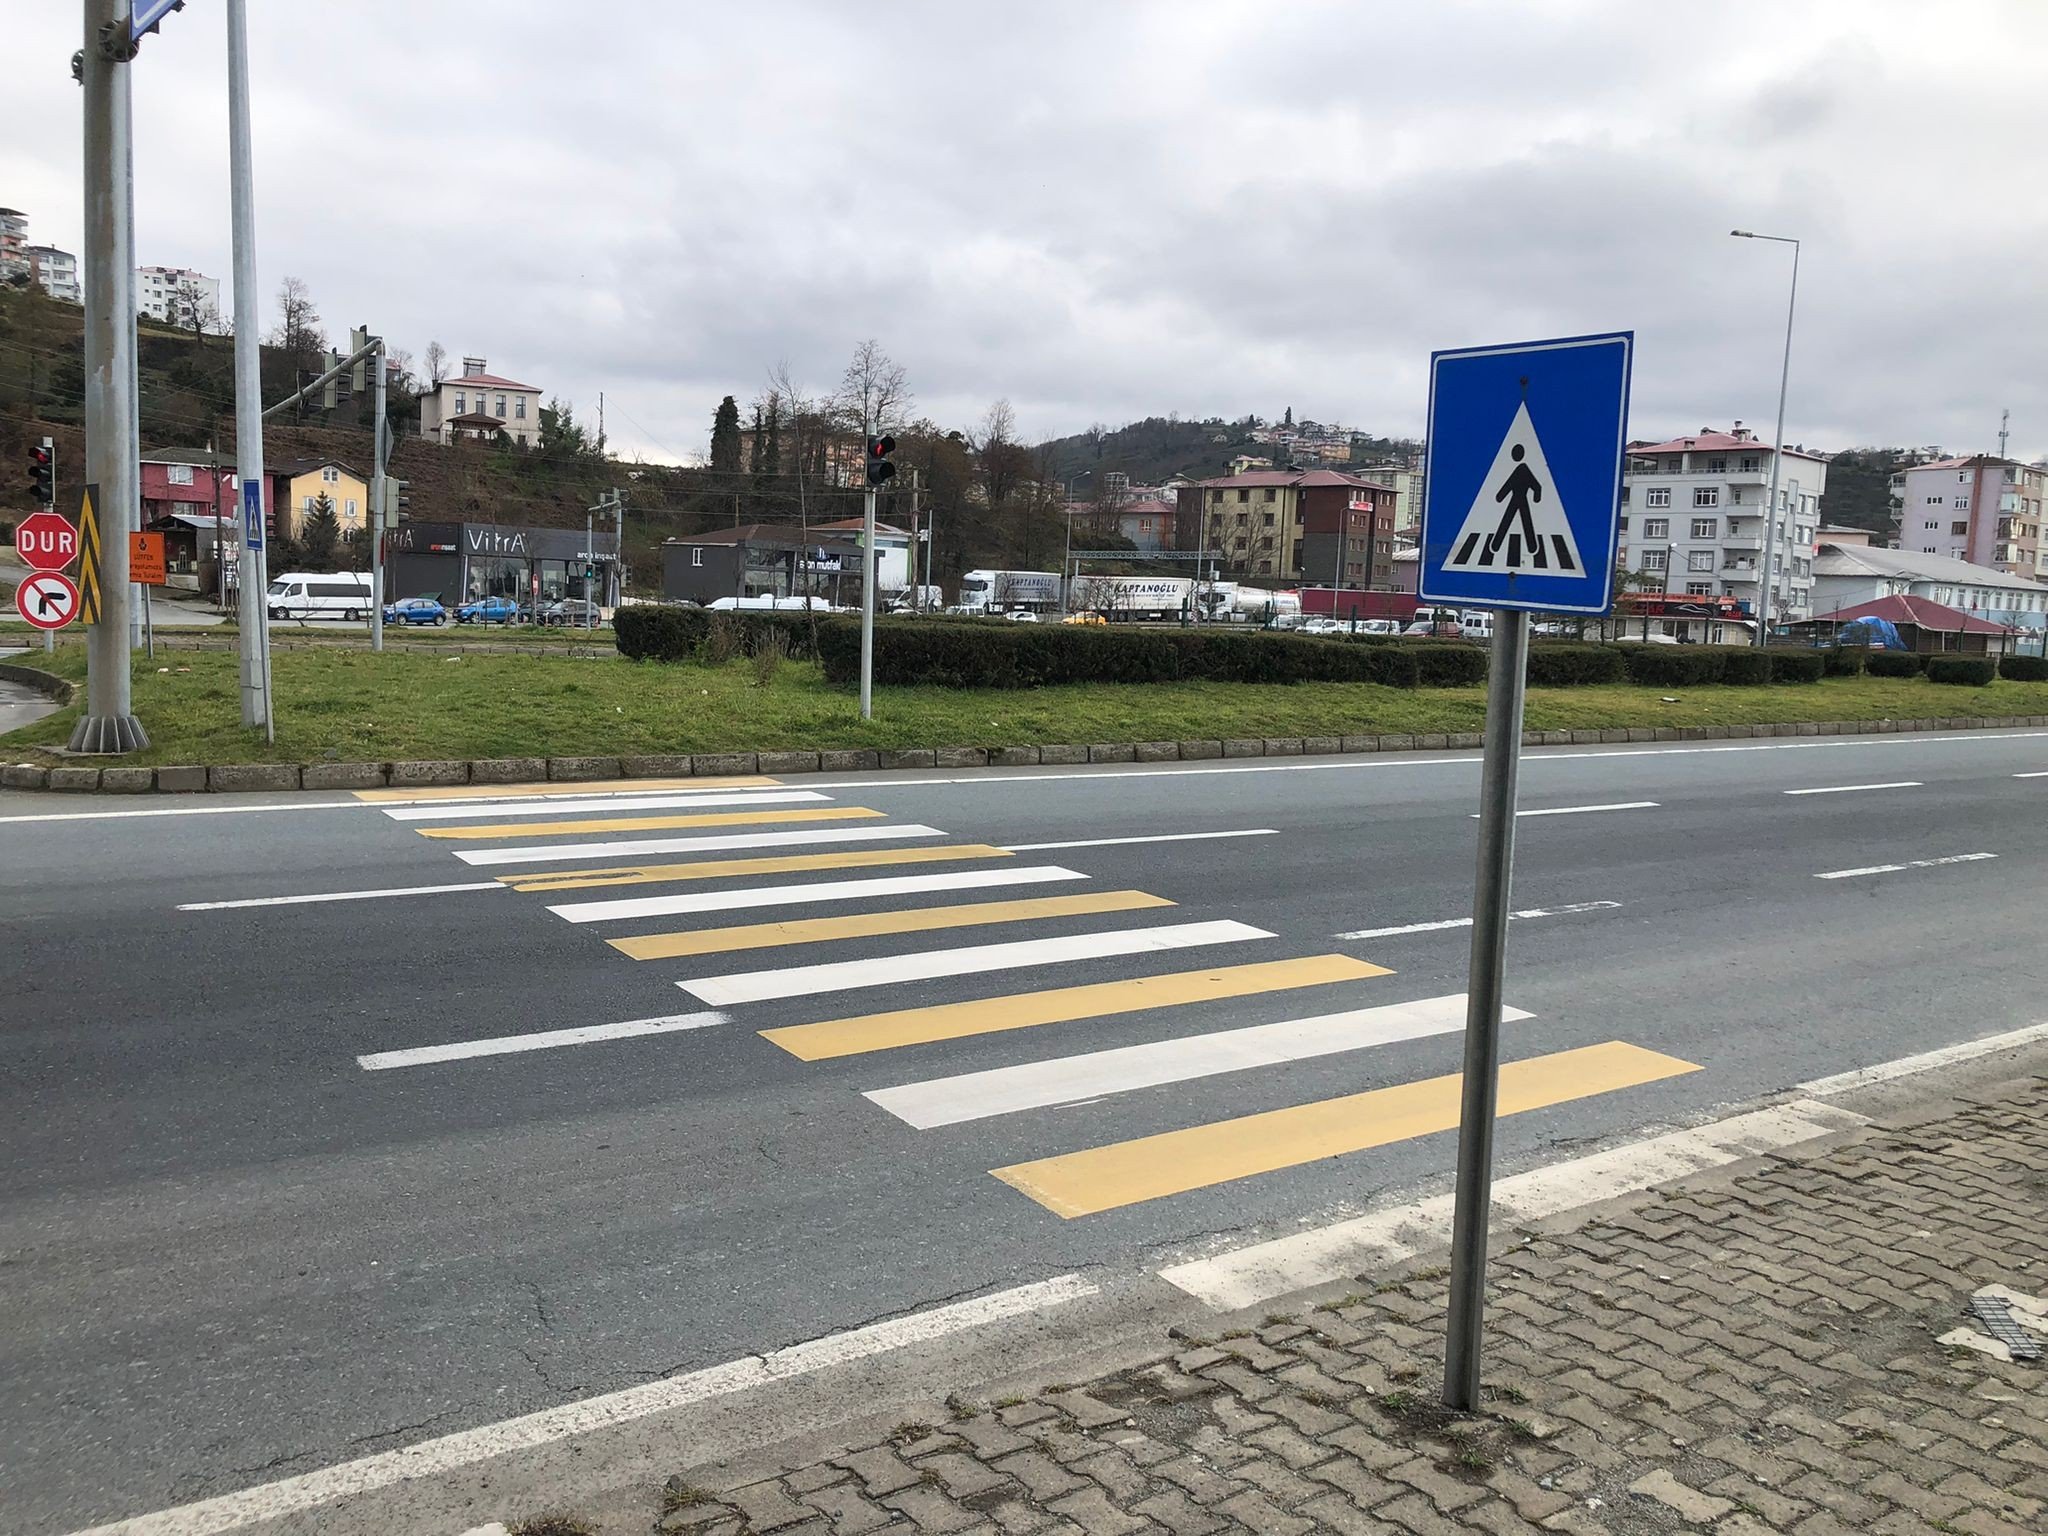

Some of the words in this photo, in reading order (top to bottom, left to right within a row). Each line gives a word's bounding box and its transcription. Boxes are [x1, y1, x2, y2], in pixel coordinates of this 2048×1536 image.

[21, 530, 73, 554] DUR
[468, 529, 526, 553] VitrA
[1113, 582, 1179, 594] KAPTANOĞLU
